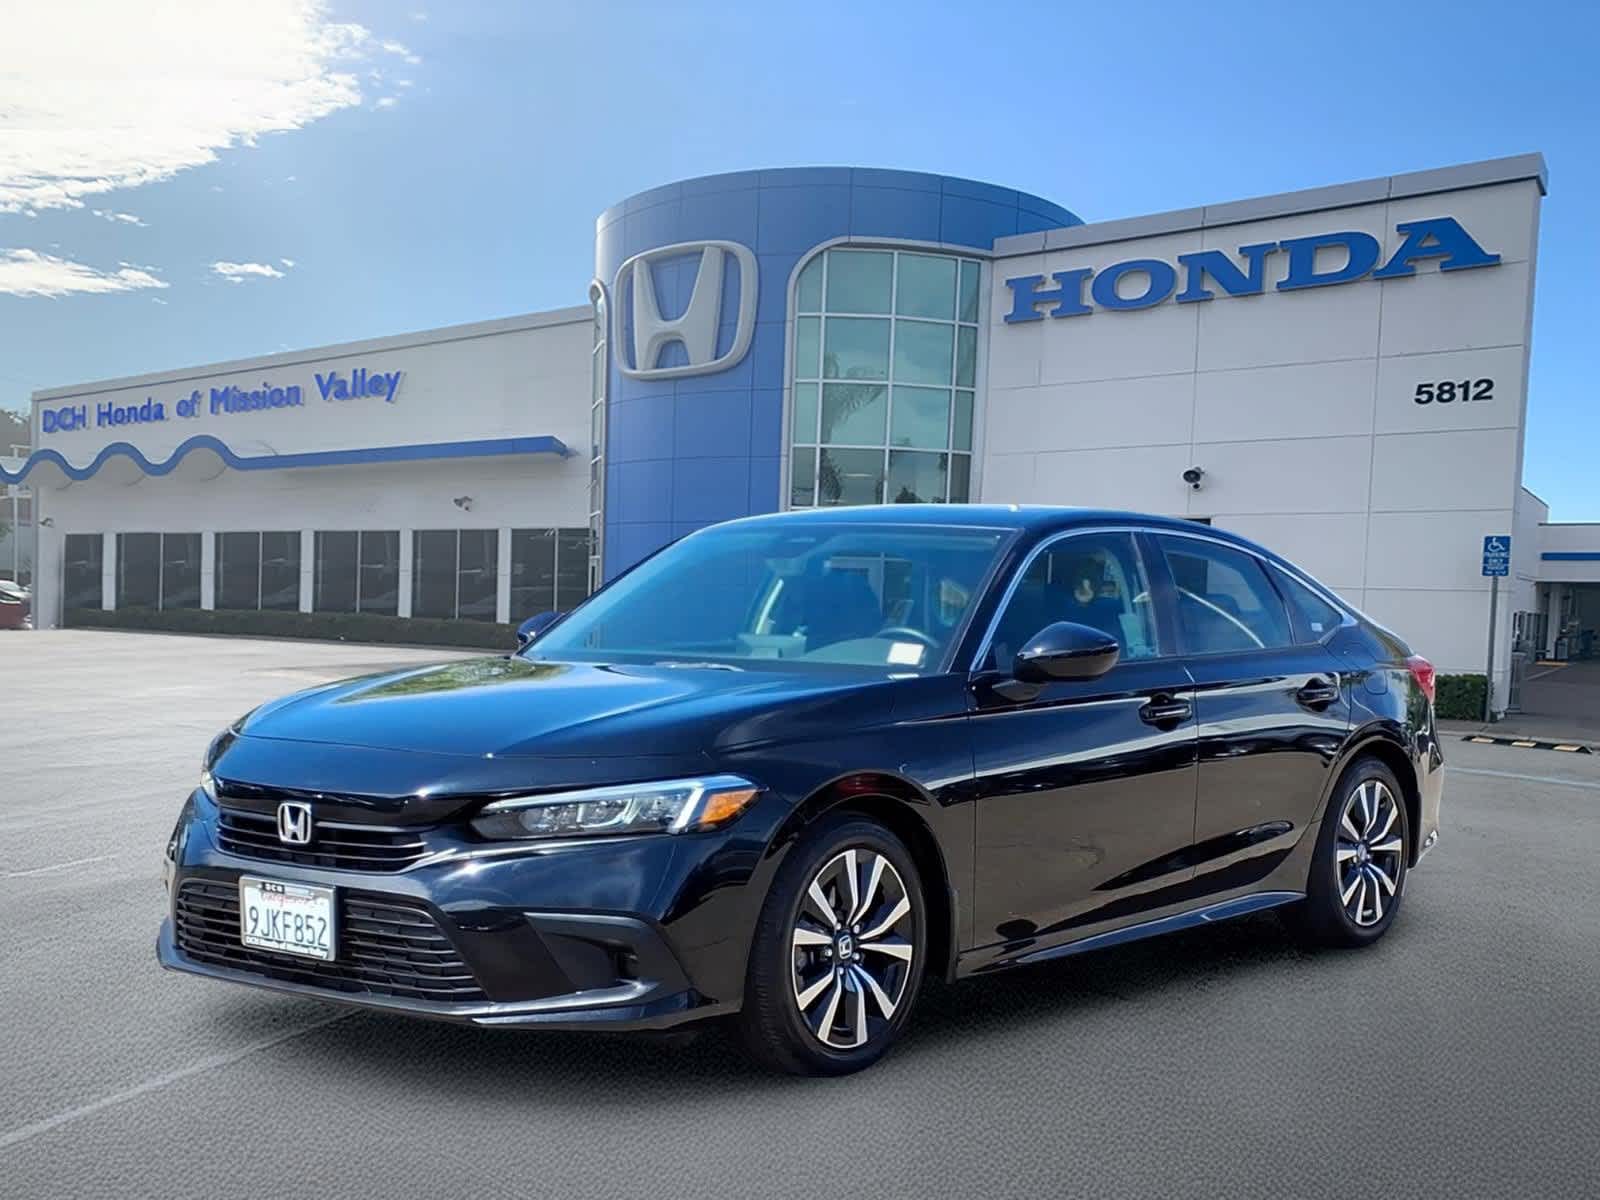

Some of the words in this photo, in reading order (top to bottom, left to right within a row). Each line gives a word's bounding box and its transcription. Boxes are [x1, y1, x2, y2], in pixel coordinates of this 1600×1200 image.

[1003, 216, 1502, 324] HONDA
[42, 404, 88, 434] DCH
[97, 397, 165, 428] Honda
[176, 390, 202, 418] of
[210, 381, 302, 415] Mission
[314, 367, 402, 403] Valley
[1414, 378, 1495, 405] 5812
[249, 905, 328, 947] 9JKF852
